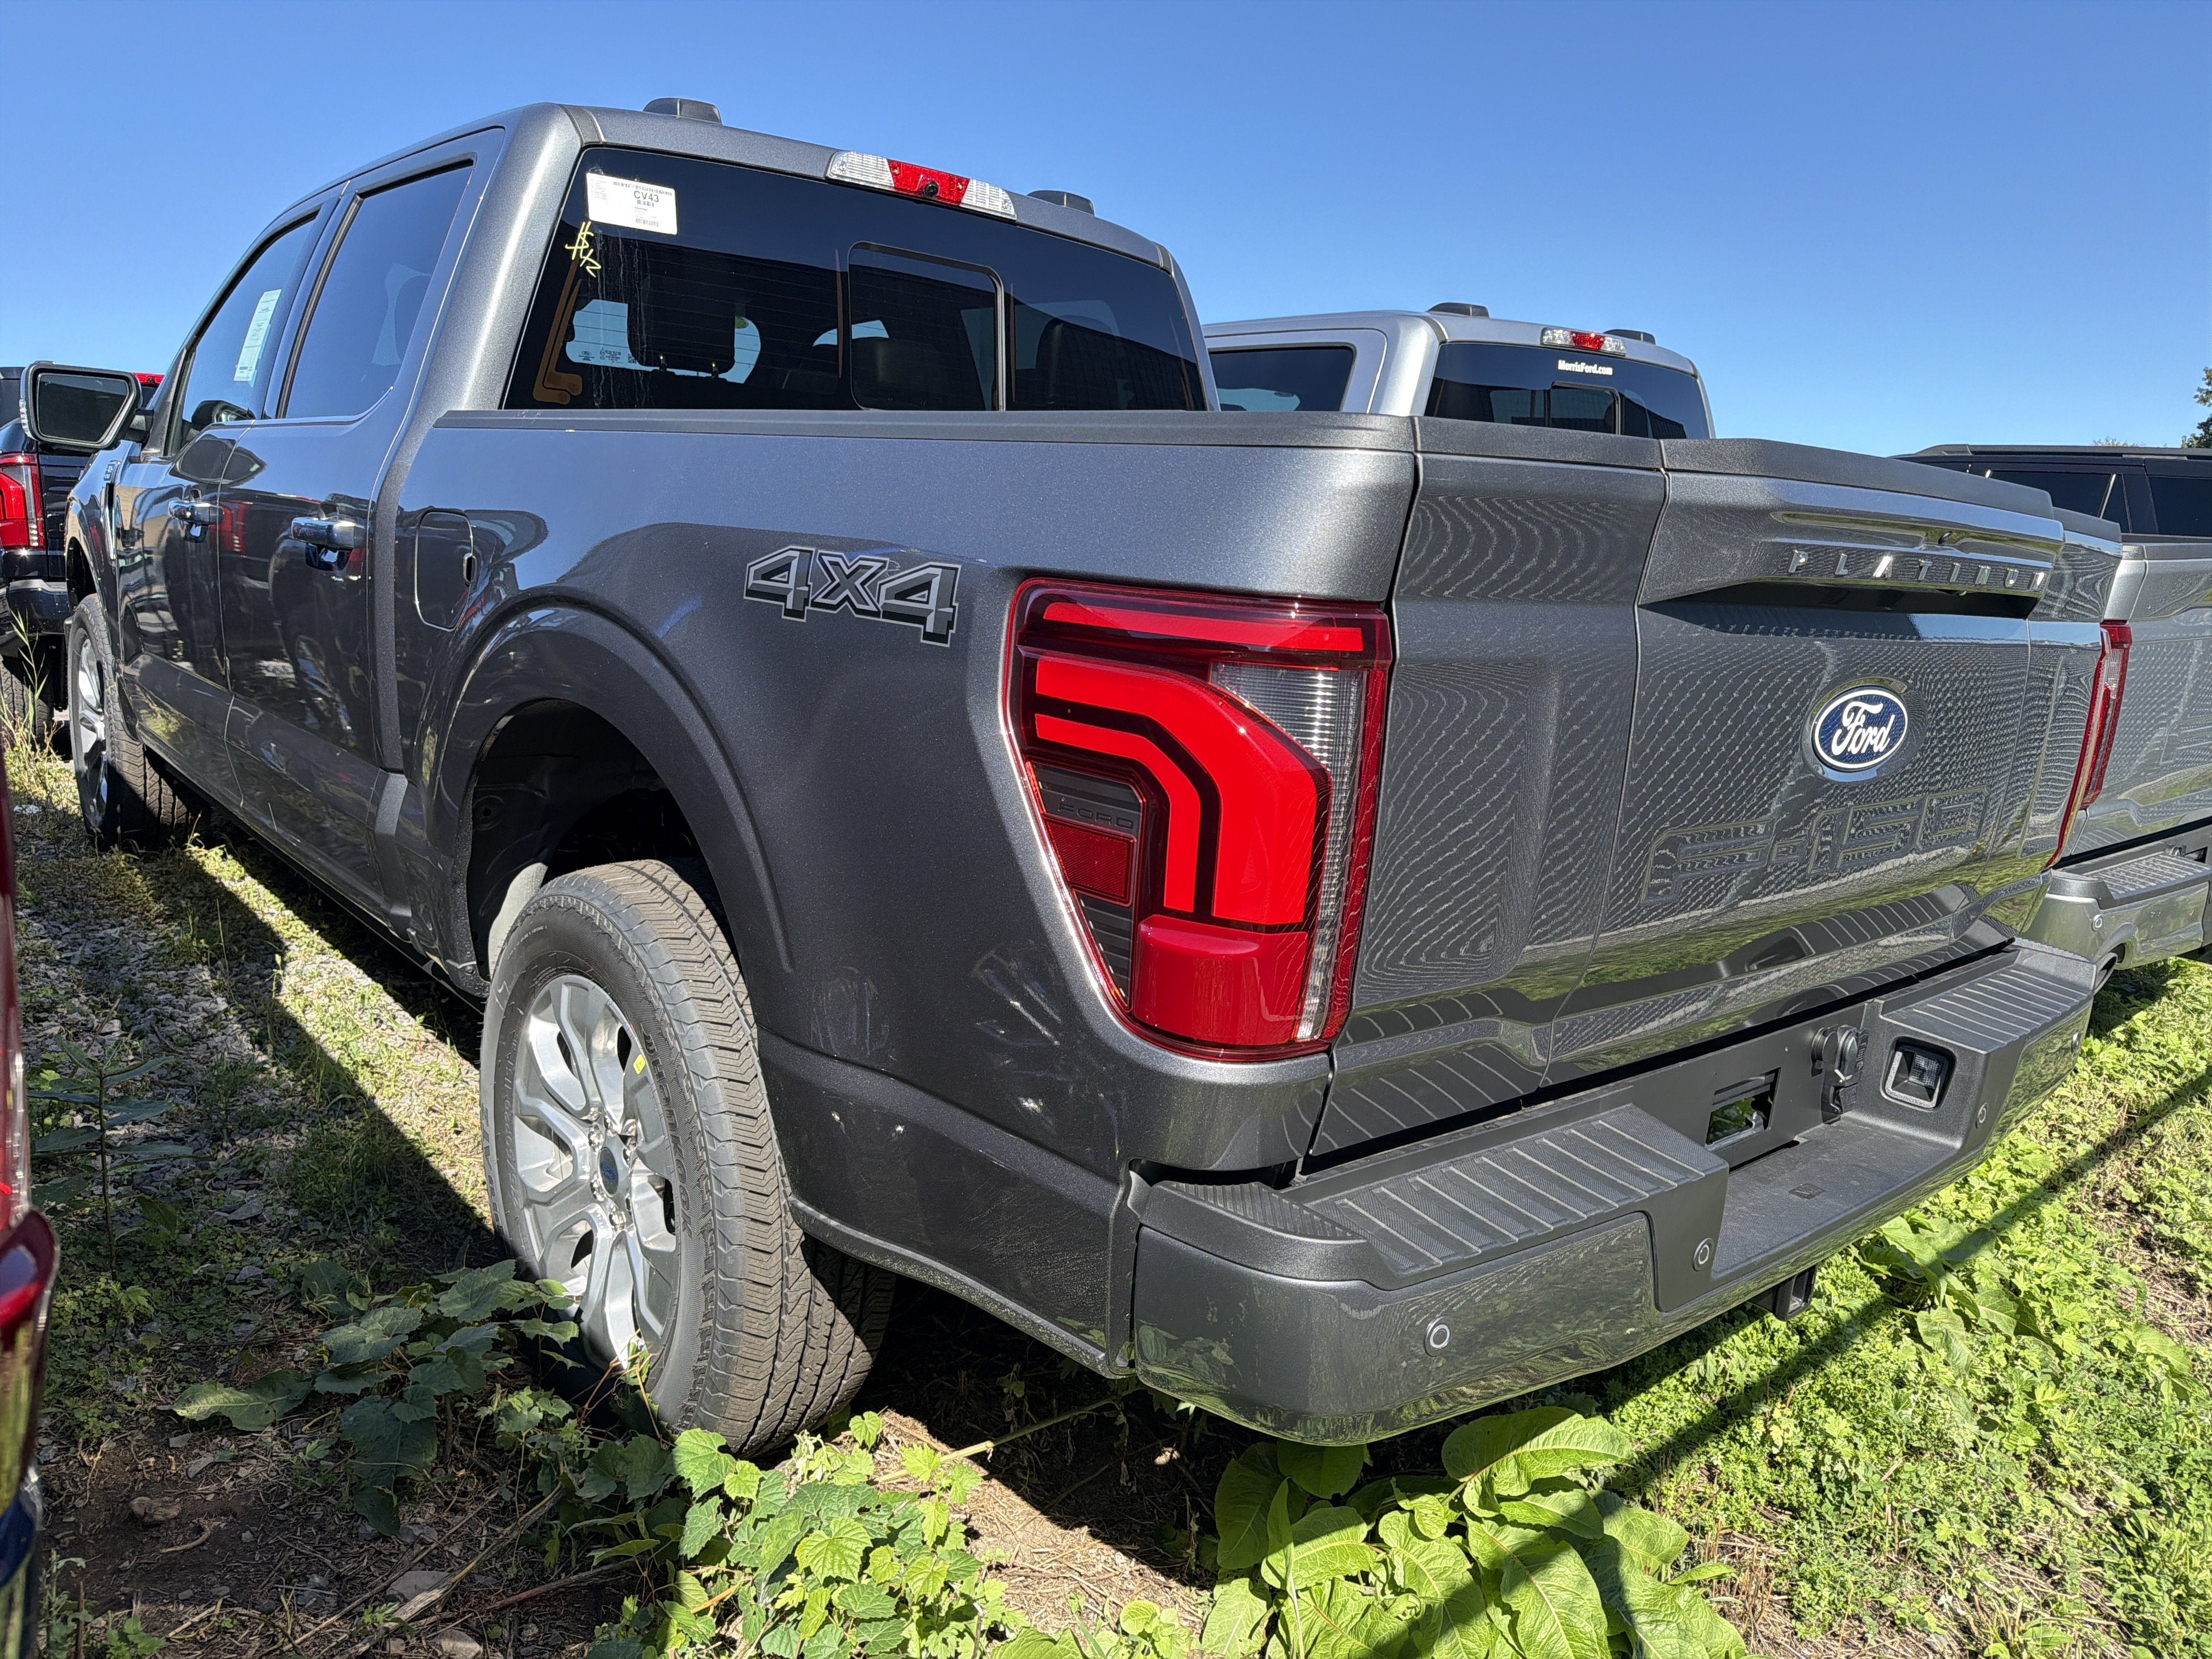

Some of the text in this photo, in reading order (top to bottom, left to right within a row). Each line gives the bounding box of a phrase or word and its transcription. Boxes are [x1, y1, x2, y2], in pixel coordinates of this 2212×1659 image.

[634, 190, 659, 203] CV43
[1558, 360, 1613, 375] MorrisFord.com
[1788, 549, 2047, 591] PLATINUM
[1831, 701, 1895, 756] Ford
[1058, 802, 1134, 829] FORD
